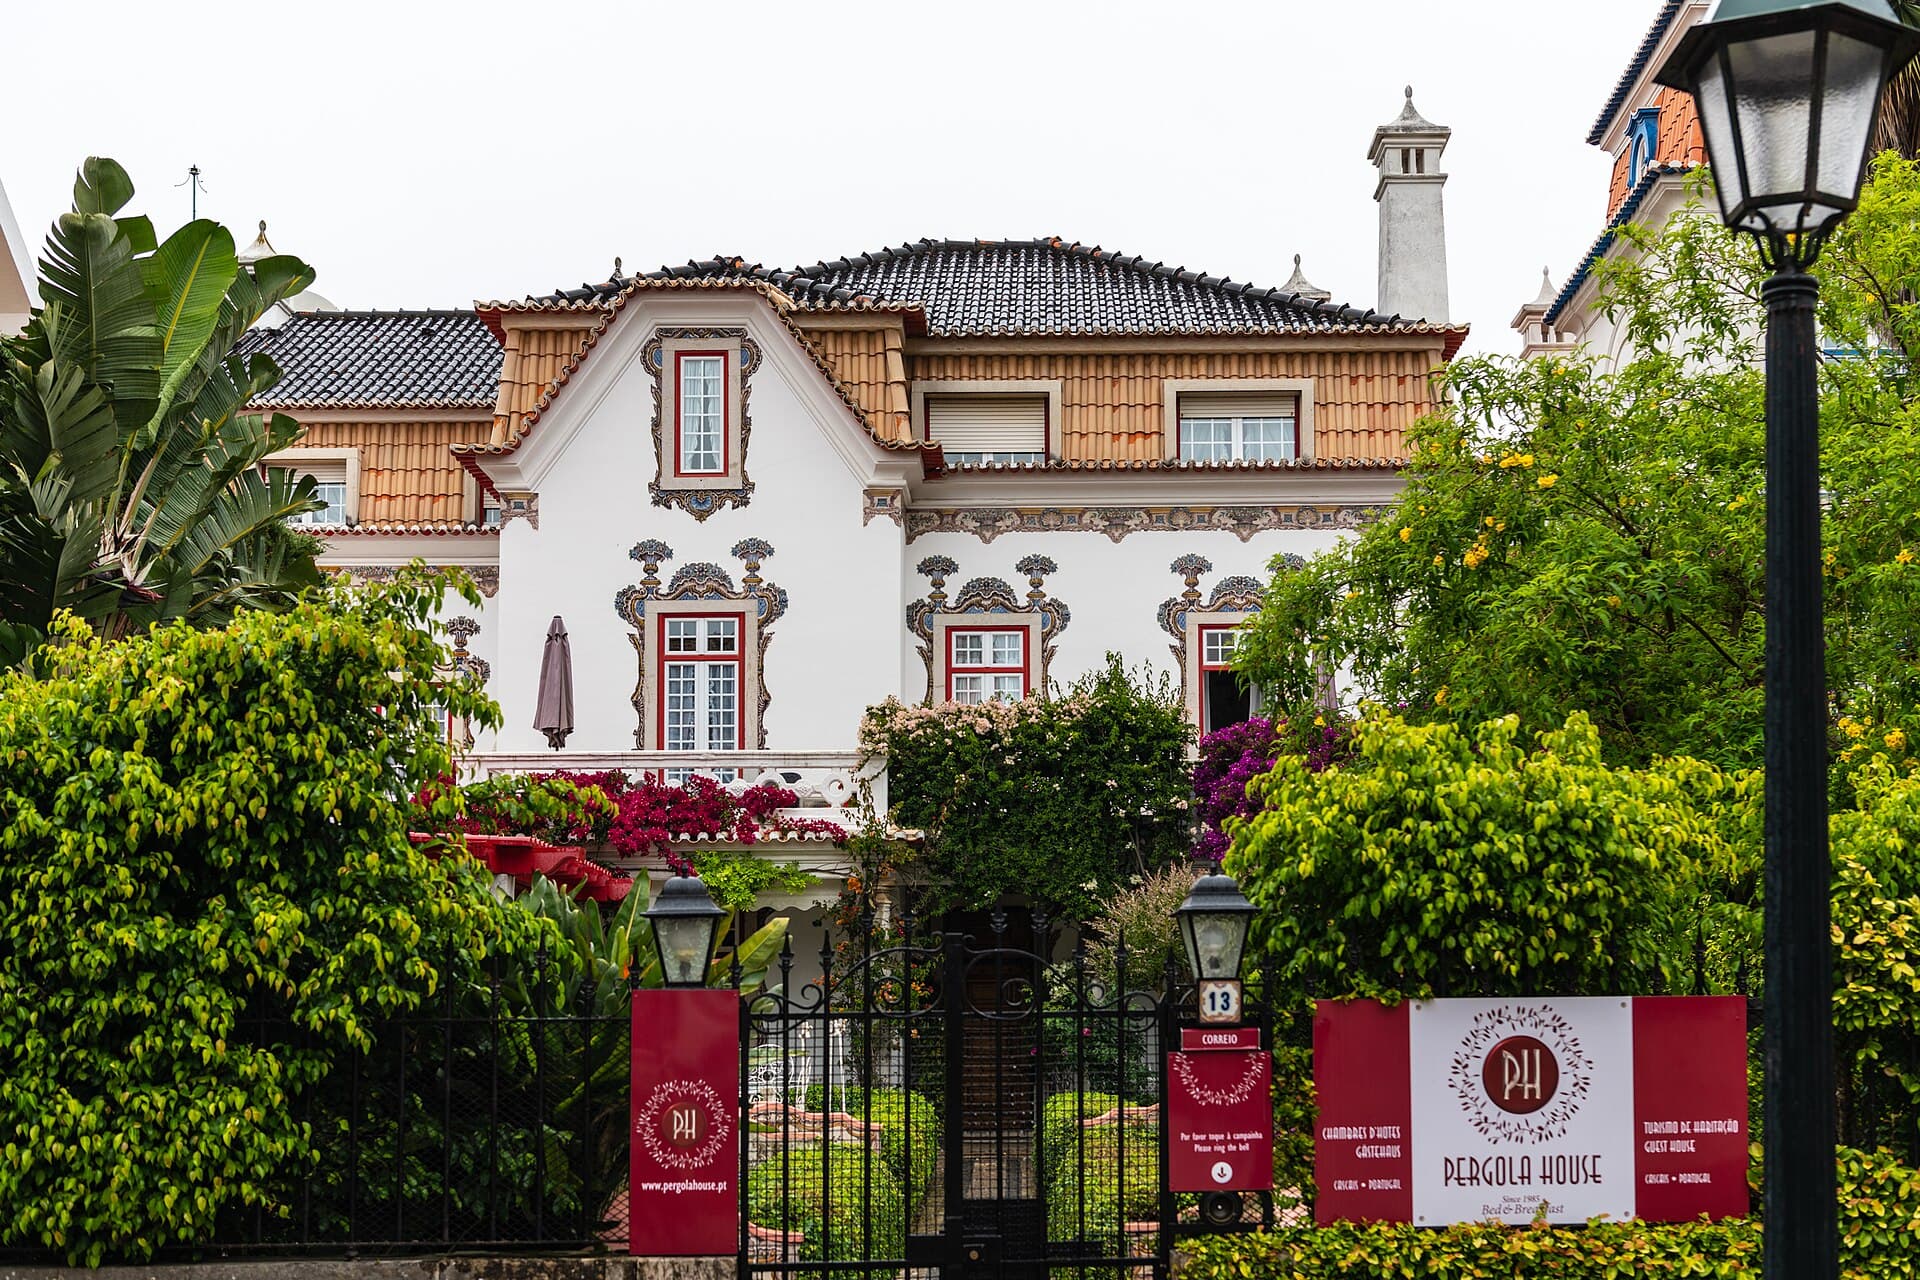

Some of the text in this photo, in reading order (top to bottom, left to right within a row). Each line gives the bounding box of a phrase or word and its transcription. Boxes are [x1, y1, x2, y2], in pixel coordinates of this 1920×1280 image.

[1209, 991, 1230, 1011] 13
[1202, 1034, 1238, 1045] CORREIO
[1502, 1048, 1541, 1100] PH
[673, 1109, 696, 1140] PH
[1643, 1118, 1739, 1135] TURISMO DE HABITAÇÃO
[1180, 1132, 1191, 1141] Por
[1192, 1132, 1207, 1141] favor
[1208, 1133, 1225, 1142] toque
[1232, 1130, 1263, 1141] campainha
[1322, 1126, 1368, 1140] CHAMBRES
[1194, 1142, 1250, 1154] Please ring the bell
[1643, 1139, 1696, 1153] GUEST HOUSE
[1443, 1154, 1602, 1187] PERGOLA HOUSE
[1333, 1179, 1402, 1191] CASCAIS PORTUGAL
[1644, 1172, 1711, 1184] CASCAIS PORTUGAL
[641, 1179, 727, 1194] www.pergolahouse.pt
[1502, 1195, 1521, 1203] Since
[1482, 1203, 1502, 1215] Bed
[1503, 1204, 1513, 1215] &
